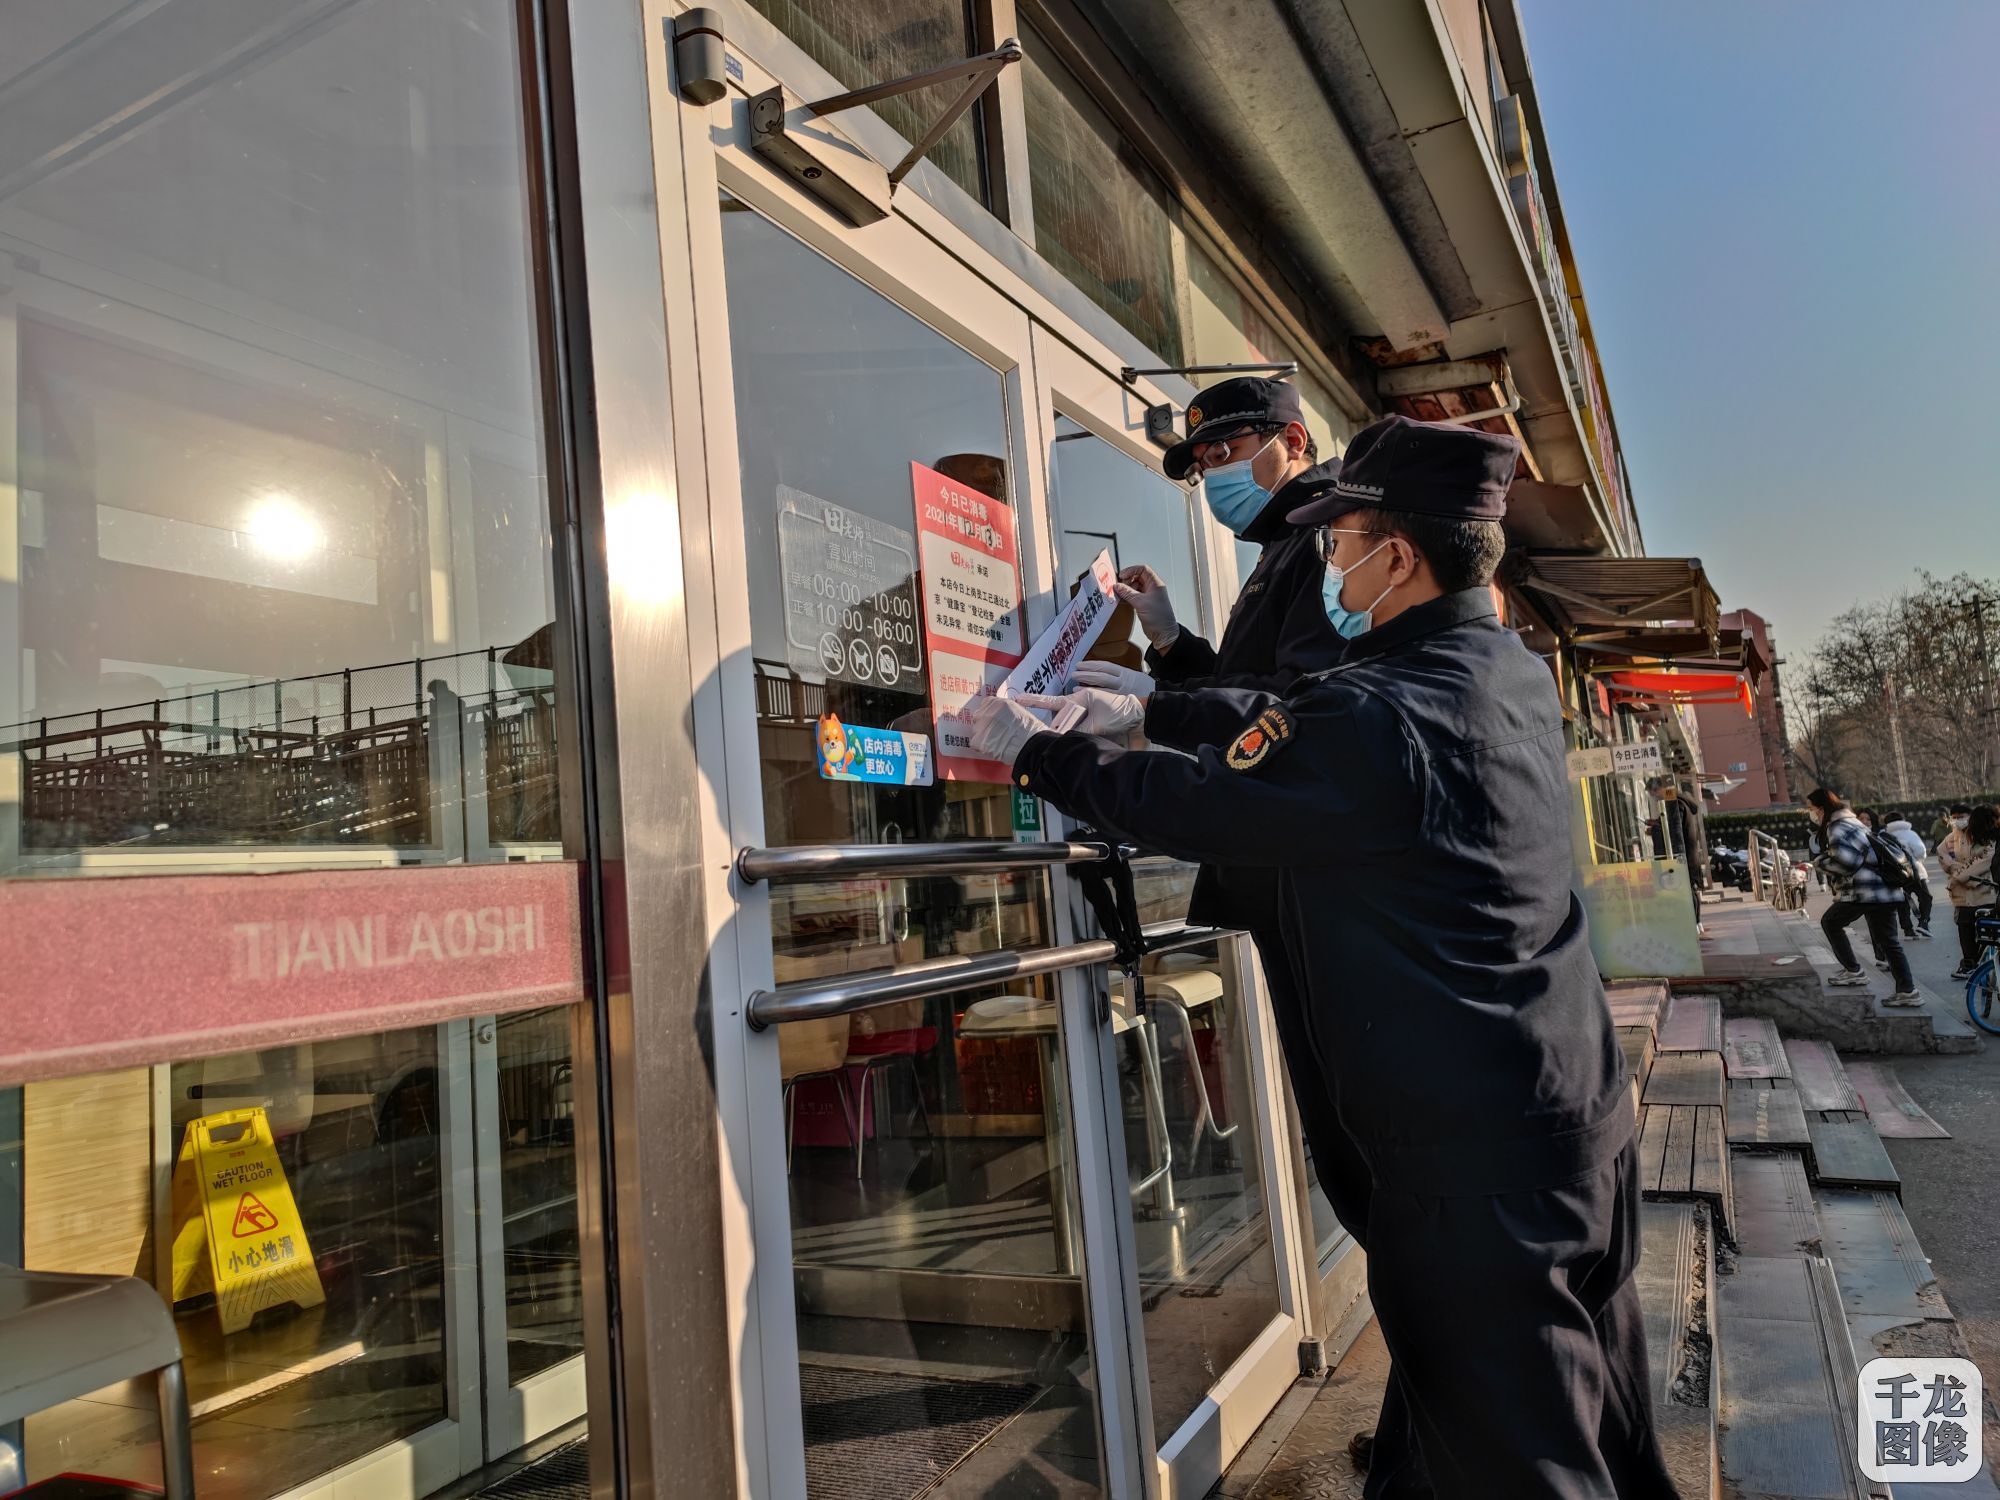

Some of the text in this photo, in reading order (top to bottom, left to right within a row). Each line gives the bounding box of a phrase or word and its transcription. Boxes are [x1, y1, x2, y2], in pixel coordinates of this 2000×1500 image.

[940, 486, 988, 521] 今日已消毒
[829, 543, 876, 572] 营业时间
[791, 572, 812, 590] 早餐
[792, 600, 815, 618] 正餐
[943, 704, 974, 725] 排队间隔
[864, 737, 903, 757] 店内消毒
[1615, 746, 1657, 761] 今日已消毒
[865, 758, 895, 776] 更放心
[1019, 792, 1036, 825] 拉
[212, 1168, 273, 1190] WET FLOOR
[217, 1161, 264, 1179] CAUTION
[228, 1235, 295, 1274] 小心地滑
